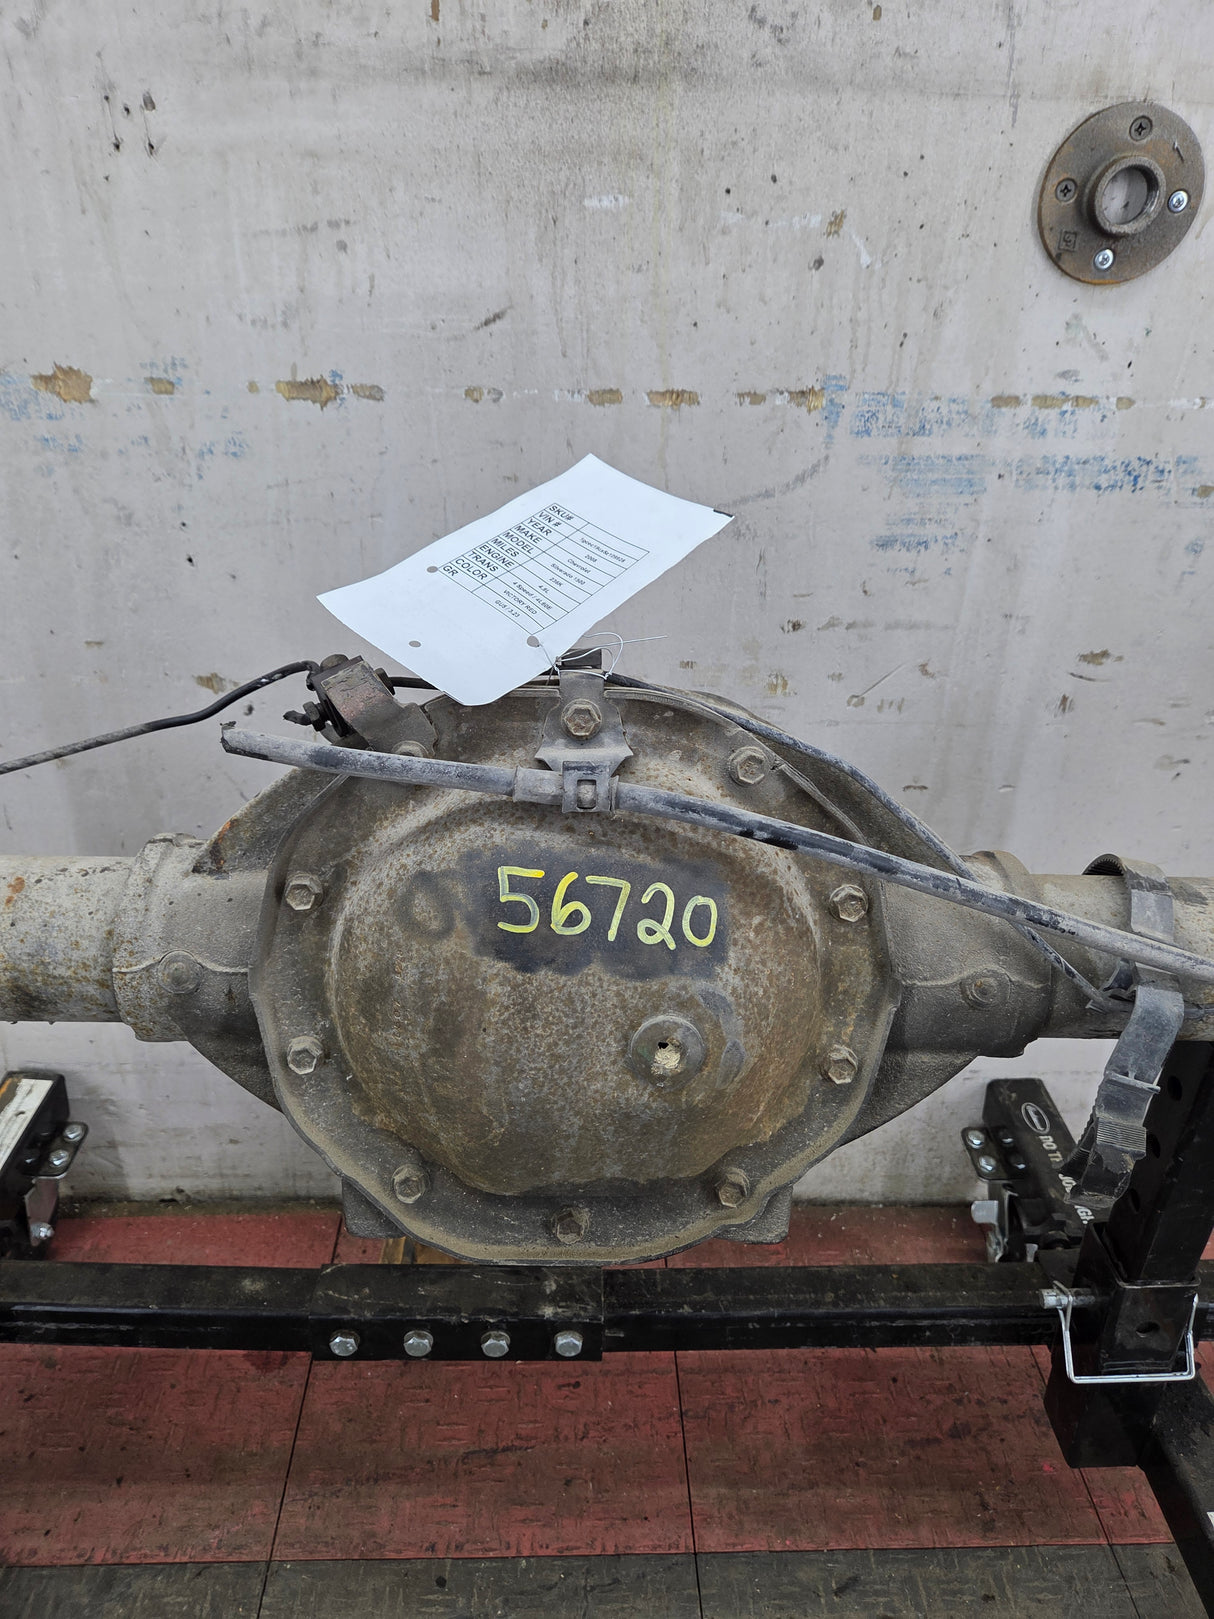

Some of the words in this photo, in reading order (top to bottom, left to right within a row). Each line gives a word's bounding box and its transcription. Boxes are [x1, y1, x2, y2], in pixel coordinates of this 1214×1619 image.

[539, 511, 555, 524] VIN
[549, 505, 574, 521] SKU#
[527, 518, 552, 536] YEAR
[479, 544, 515, 568] ENGINE
[491, 538, 520, 557] MILES
[502, 532, 535, 554] MODEL
[550, 563, 573, 578] Silverado
[514, 525, 543, 544] MAKE
[567, 558, 591, 574] Chevrolet
[443, 565, 459, 576] GR
[469, 550, 499, 572] TRANS
[516, 584, 535, 597] Speed
[455, 558, 488, 580] COLOR
[503, 589, 527, 606] VICTORY
[524, 604, 538, 615] RED
[498, 866, 718, 950] 56720
